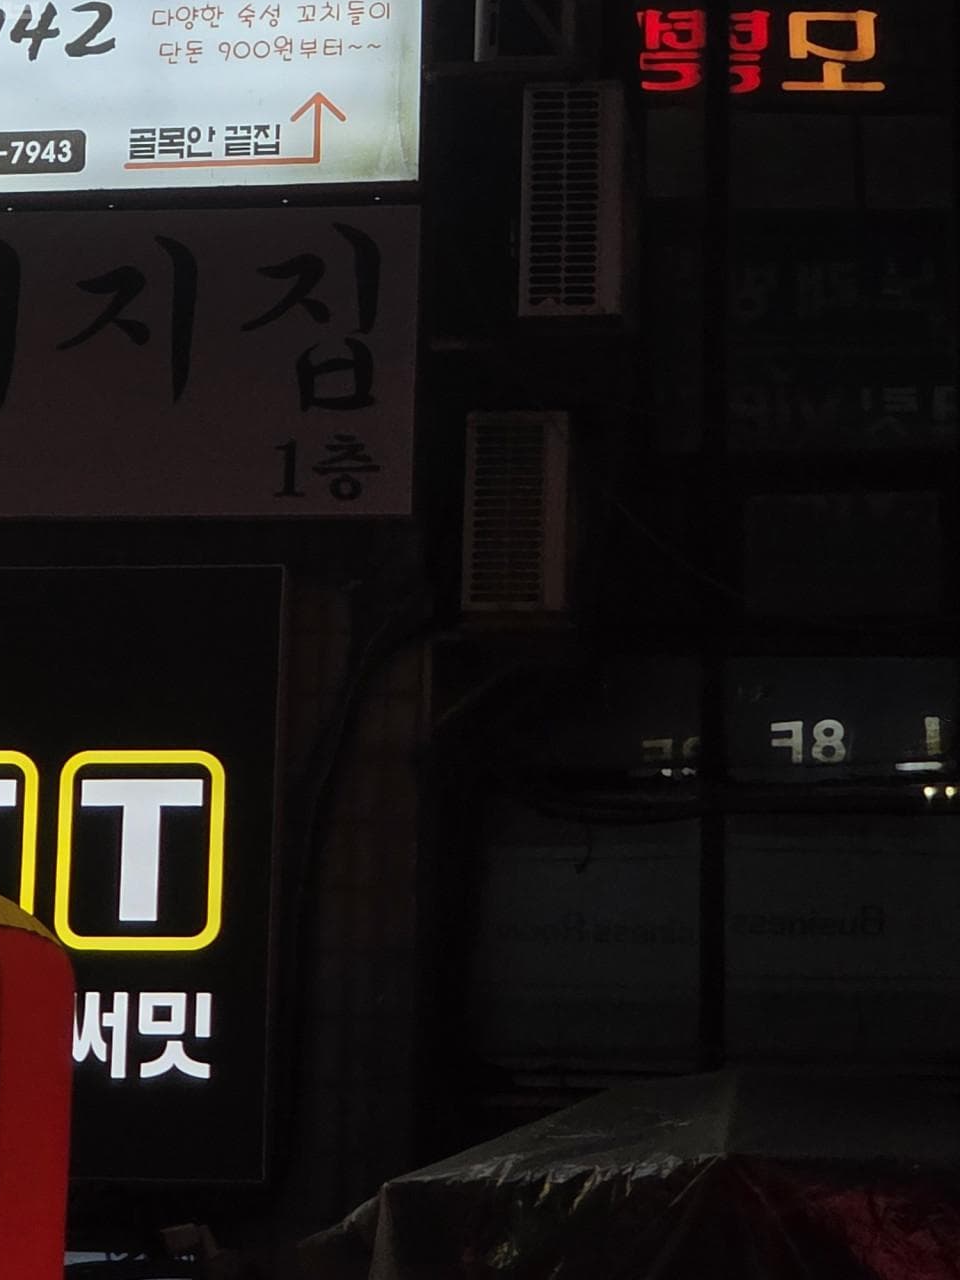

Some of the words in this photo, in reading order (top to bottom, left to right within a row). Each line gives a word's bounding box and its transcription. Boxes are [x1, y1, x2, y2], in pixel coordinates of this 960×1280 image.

[152, 3, 224, 30] 다양한
[238, 3, 281, 28] 숙성
[297, 0, 391, 26] 꼬치들이
[159, 40, 203, 64] 단돈
[129, 126, 216, 160] 골목안
[273, 433, 381, 501] 1층
